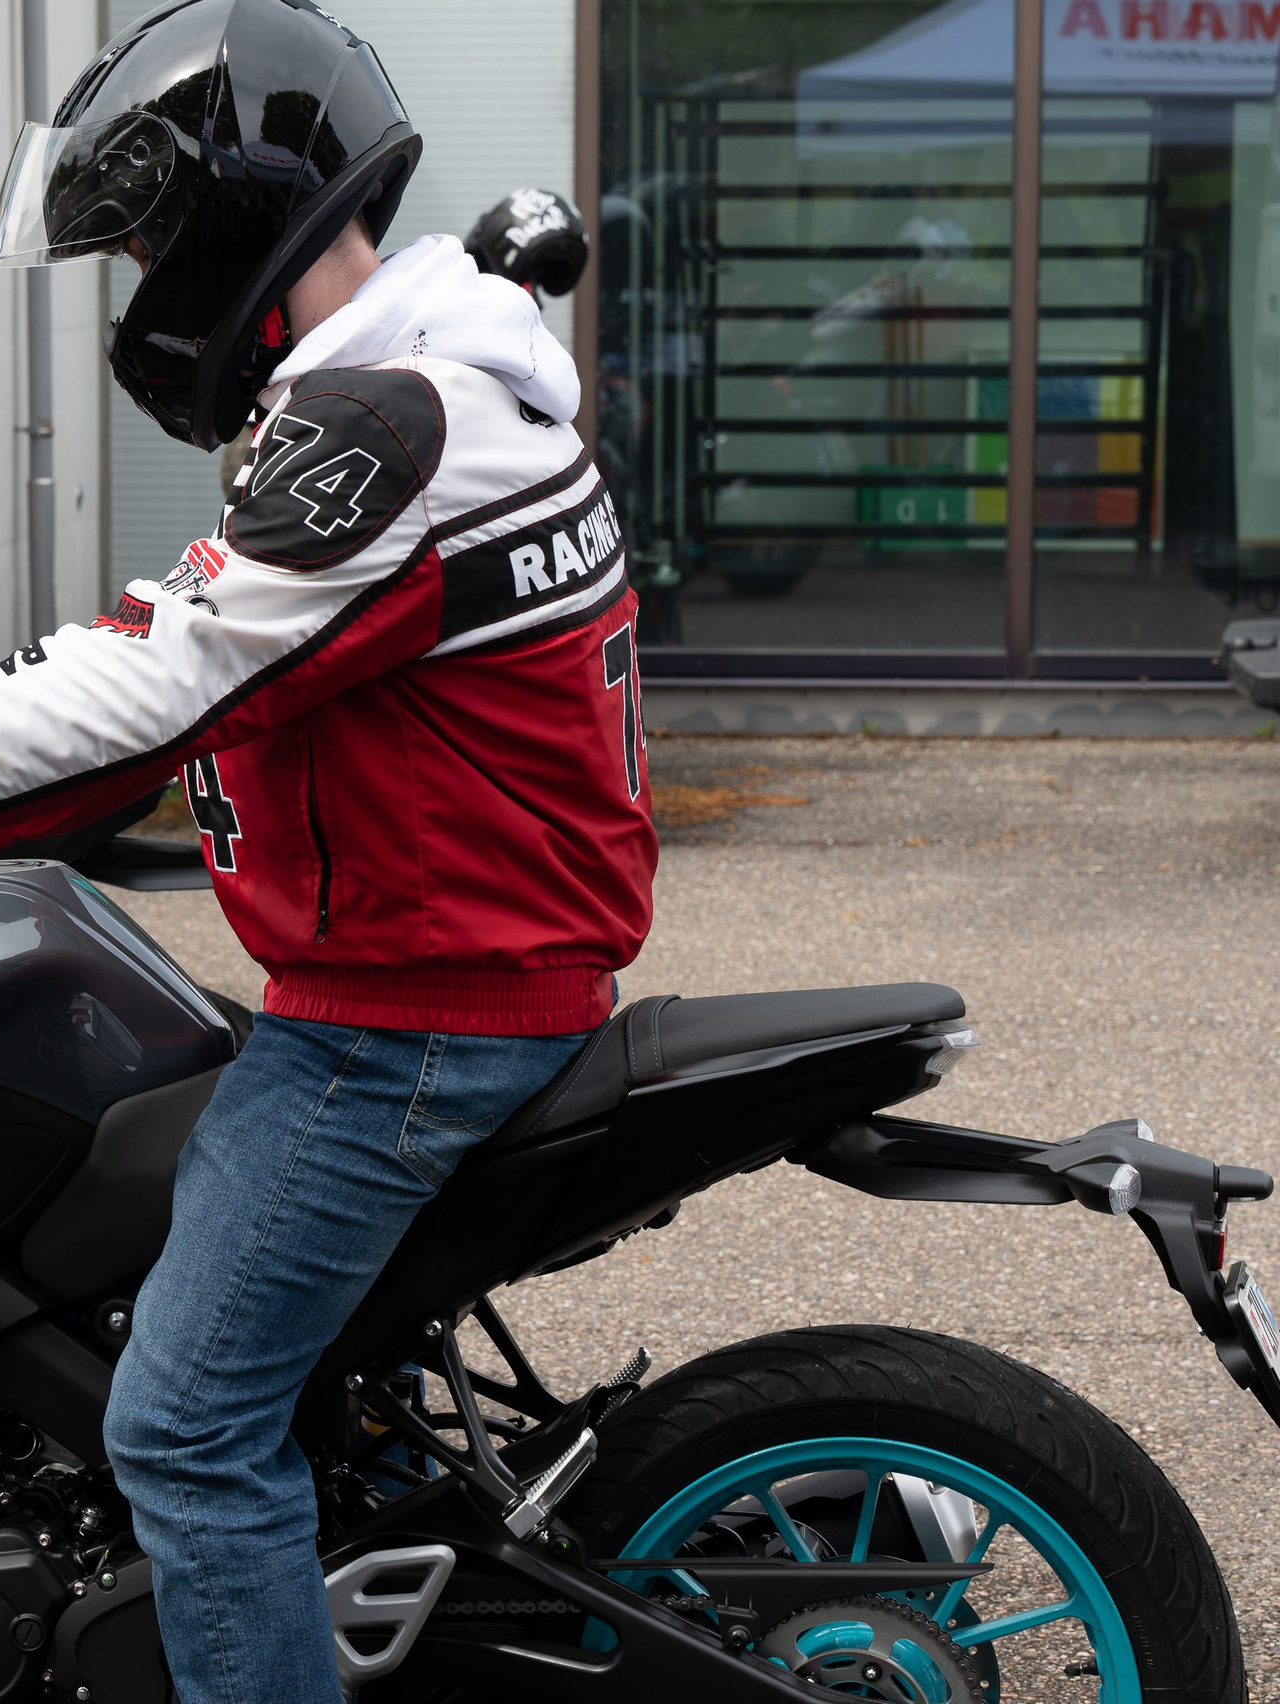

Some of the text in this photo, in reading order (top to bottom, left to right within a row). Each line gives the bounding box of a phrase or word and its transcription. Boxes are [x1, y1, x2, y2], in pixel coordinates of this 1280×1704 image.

[251, 413, 382, 537] 74
[509, 502, 617, 598] RACING
[602, 606, 647, 803] 7
